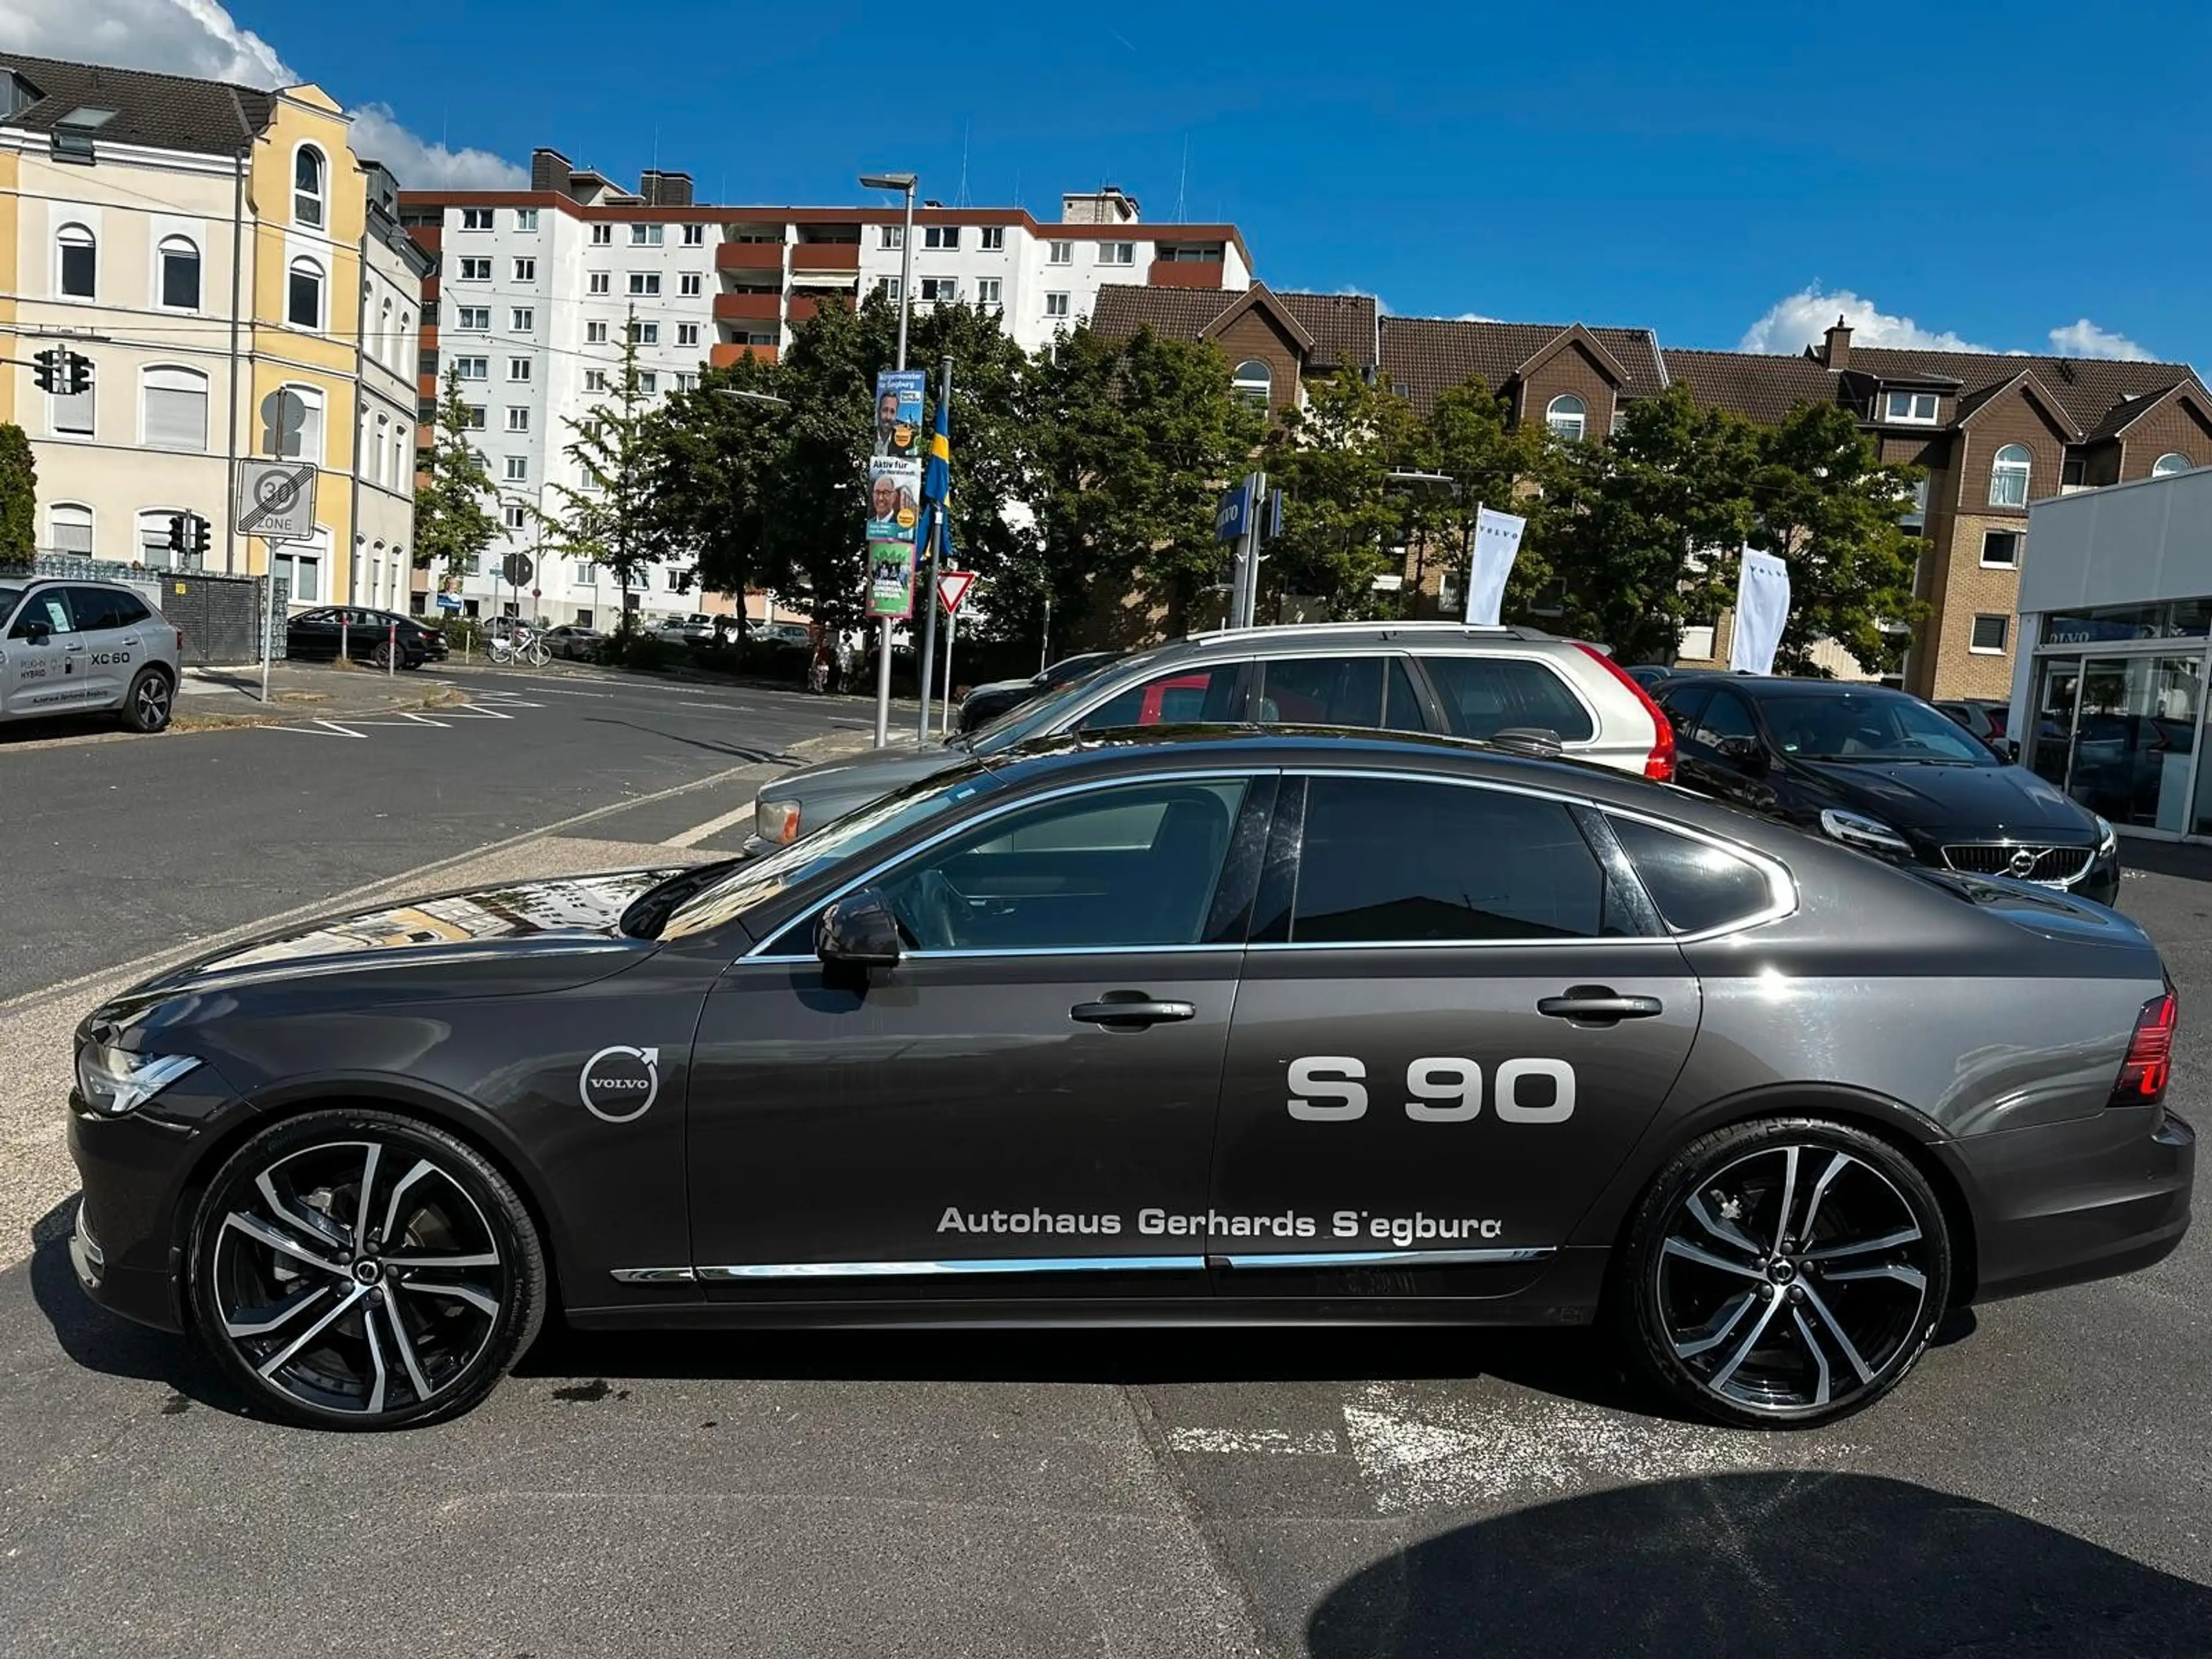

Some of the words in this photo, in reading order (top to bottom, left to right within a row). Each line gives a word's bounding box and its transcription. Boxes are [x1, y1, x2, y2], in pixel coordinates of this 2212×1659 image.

[873, 460, 893, 468] Aktiv
[257, 517, 292, 530] ZONE
[1480, 525, 1518, 540] VOLVO
[21, 669, 46, 679] HYBRID
[590, 1078, 649, 1089] VOLVO
[1287, 1056, 1369, 1122] S
[1405, 1057, 1577, 1124] 90
[937, 1207, 1121, 1234] Autohaus
[1138, 1208, 1316, 1237] Gerhards
[1332, 1210, 1501, 1247] Segbur
